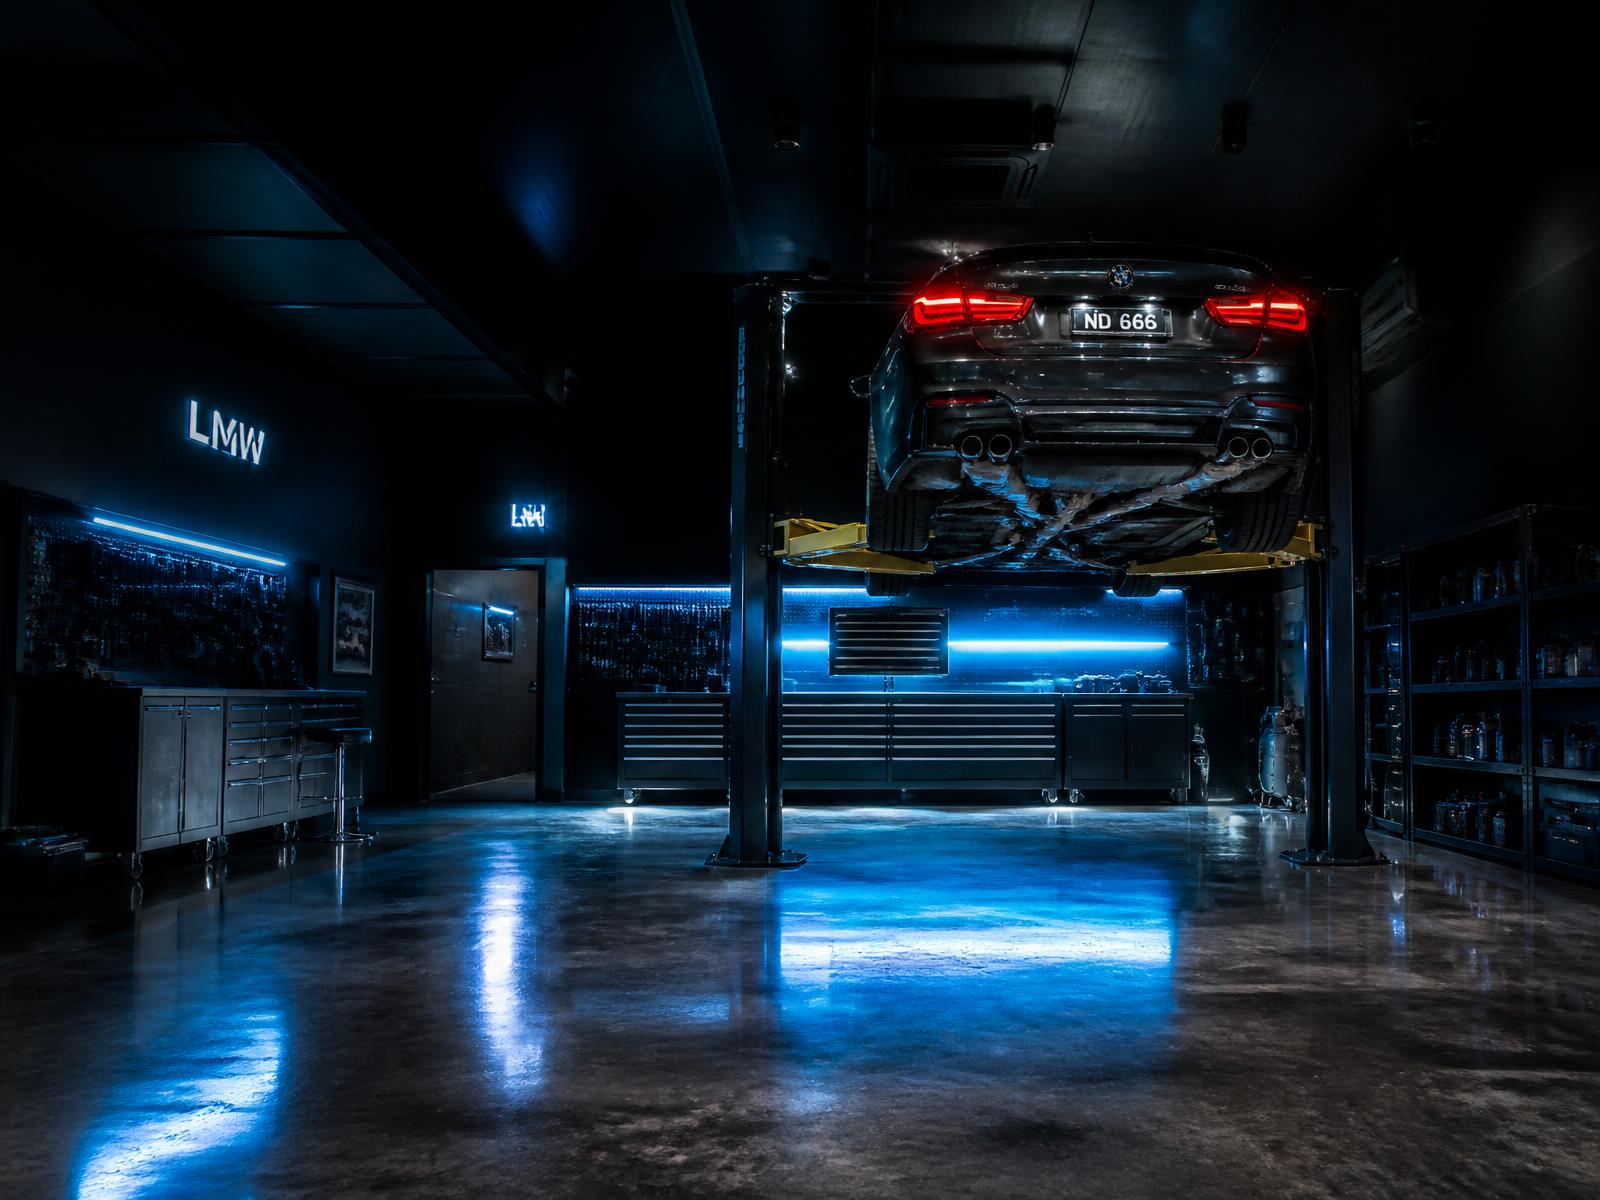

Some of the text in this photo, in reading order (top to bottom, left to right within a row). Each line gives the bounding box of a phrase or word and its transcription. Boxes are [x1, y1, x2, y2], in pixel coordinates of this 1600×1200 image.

[1084, 312, 1157, 330] ND 666
[188, 399, 265, 465] LMW
